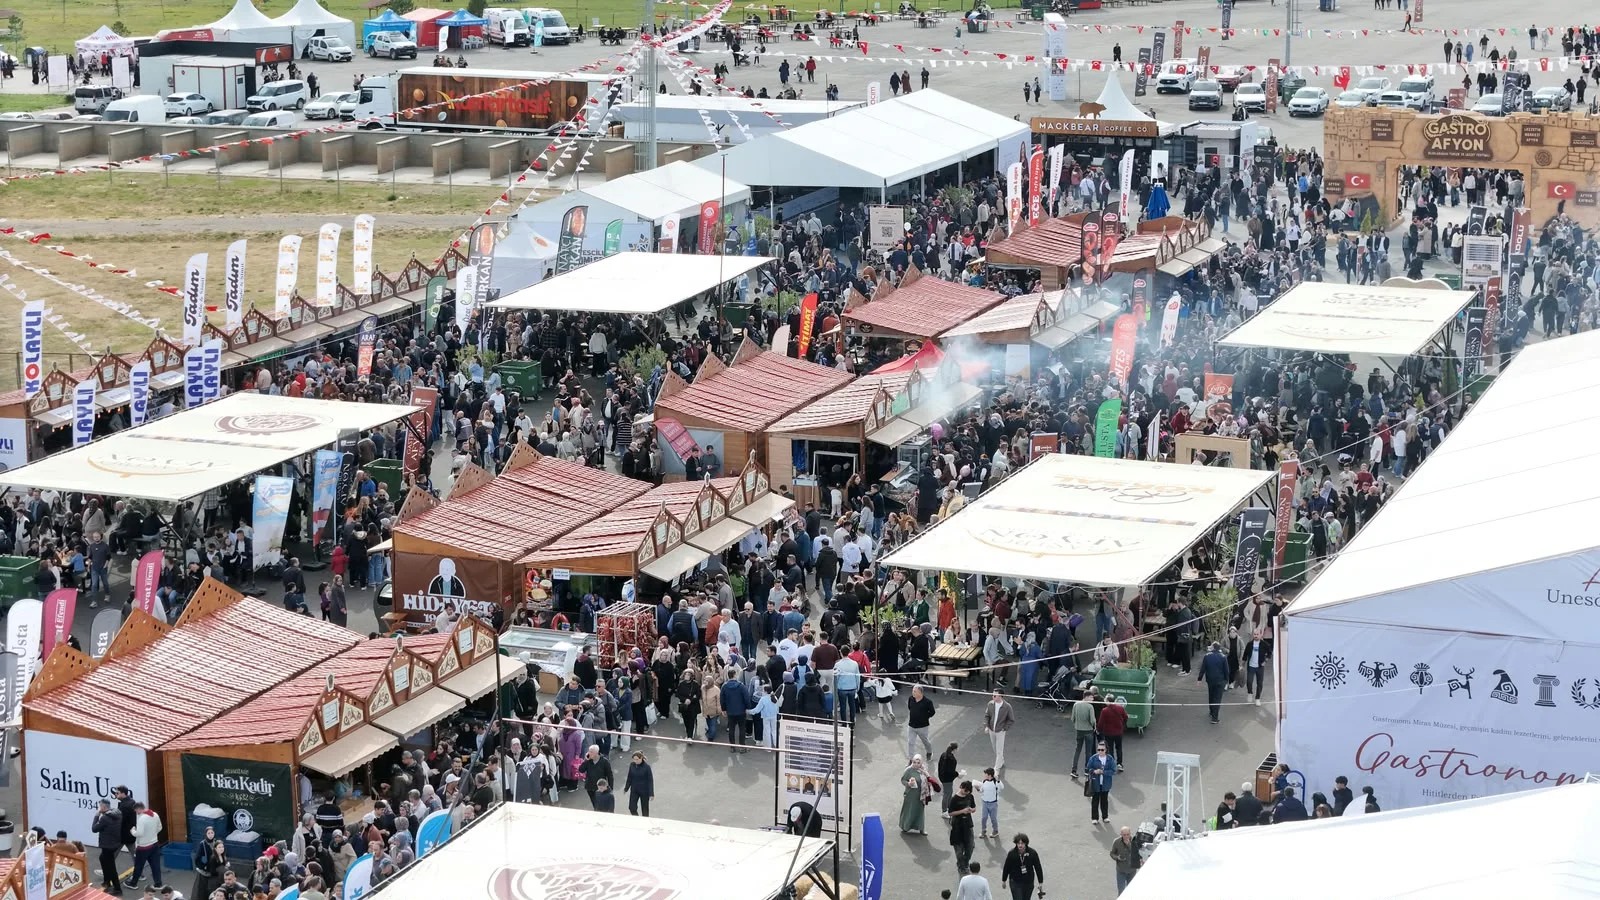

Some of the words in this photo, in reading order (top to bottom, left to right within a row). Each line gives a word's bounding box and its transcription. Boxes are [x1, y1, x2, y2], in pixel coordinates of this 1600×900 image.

[1039, 122, 1099, 131] MACKBEAR
[1427, 122, 1488, 136] GASTRO
[1431, 137, 1484, 151] AFYON
[1032, 195, 1040, 219] ECE
[1514, 224, 1525, 253] DOLU
[569, 237, 583, 273] RKAN
[25, 311, 42, 393] KOLAYLI
[188, 356, 204, 408] LAYLI
[204, 348, 219, 398] LAYLI
[133, 371, 148, 423] LAYLI
[76, 389, 94, 443] LAYLI
[1101, 423, 1109, 447] USTA
[146, 562, 155, 585] Efendi
[1238, 547, 1255, 593] AFYON
[55, 598, 65, 625] Efendi
[1546, 588, 1600, 608] Unesc
[12, 624, 28, 657] Usta
[1372, 716, 1411, 725] Gastronomi
[1433, 721, 1458, 731] Müzesi,
[1491, 727, 1512, 736] kadim
[1355, 732, 1585, 787] Gastronom
[40, 767, 91, 796] Salim
[94, 775, 134, 800] Usa
[205, 772, 240, 790] Hacı
[239, 776, 275, 797] Kadir
[1422, 788, 1468, 801] Hititlerden
[77, 798, 99, 811] 1934
